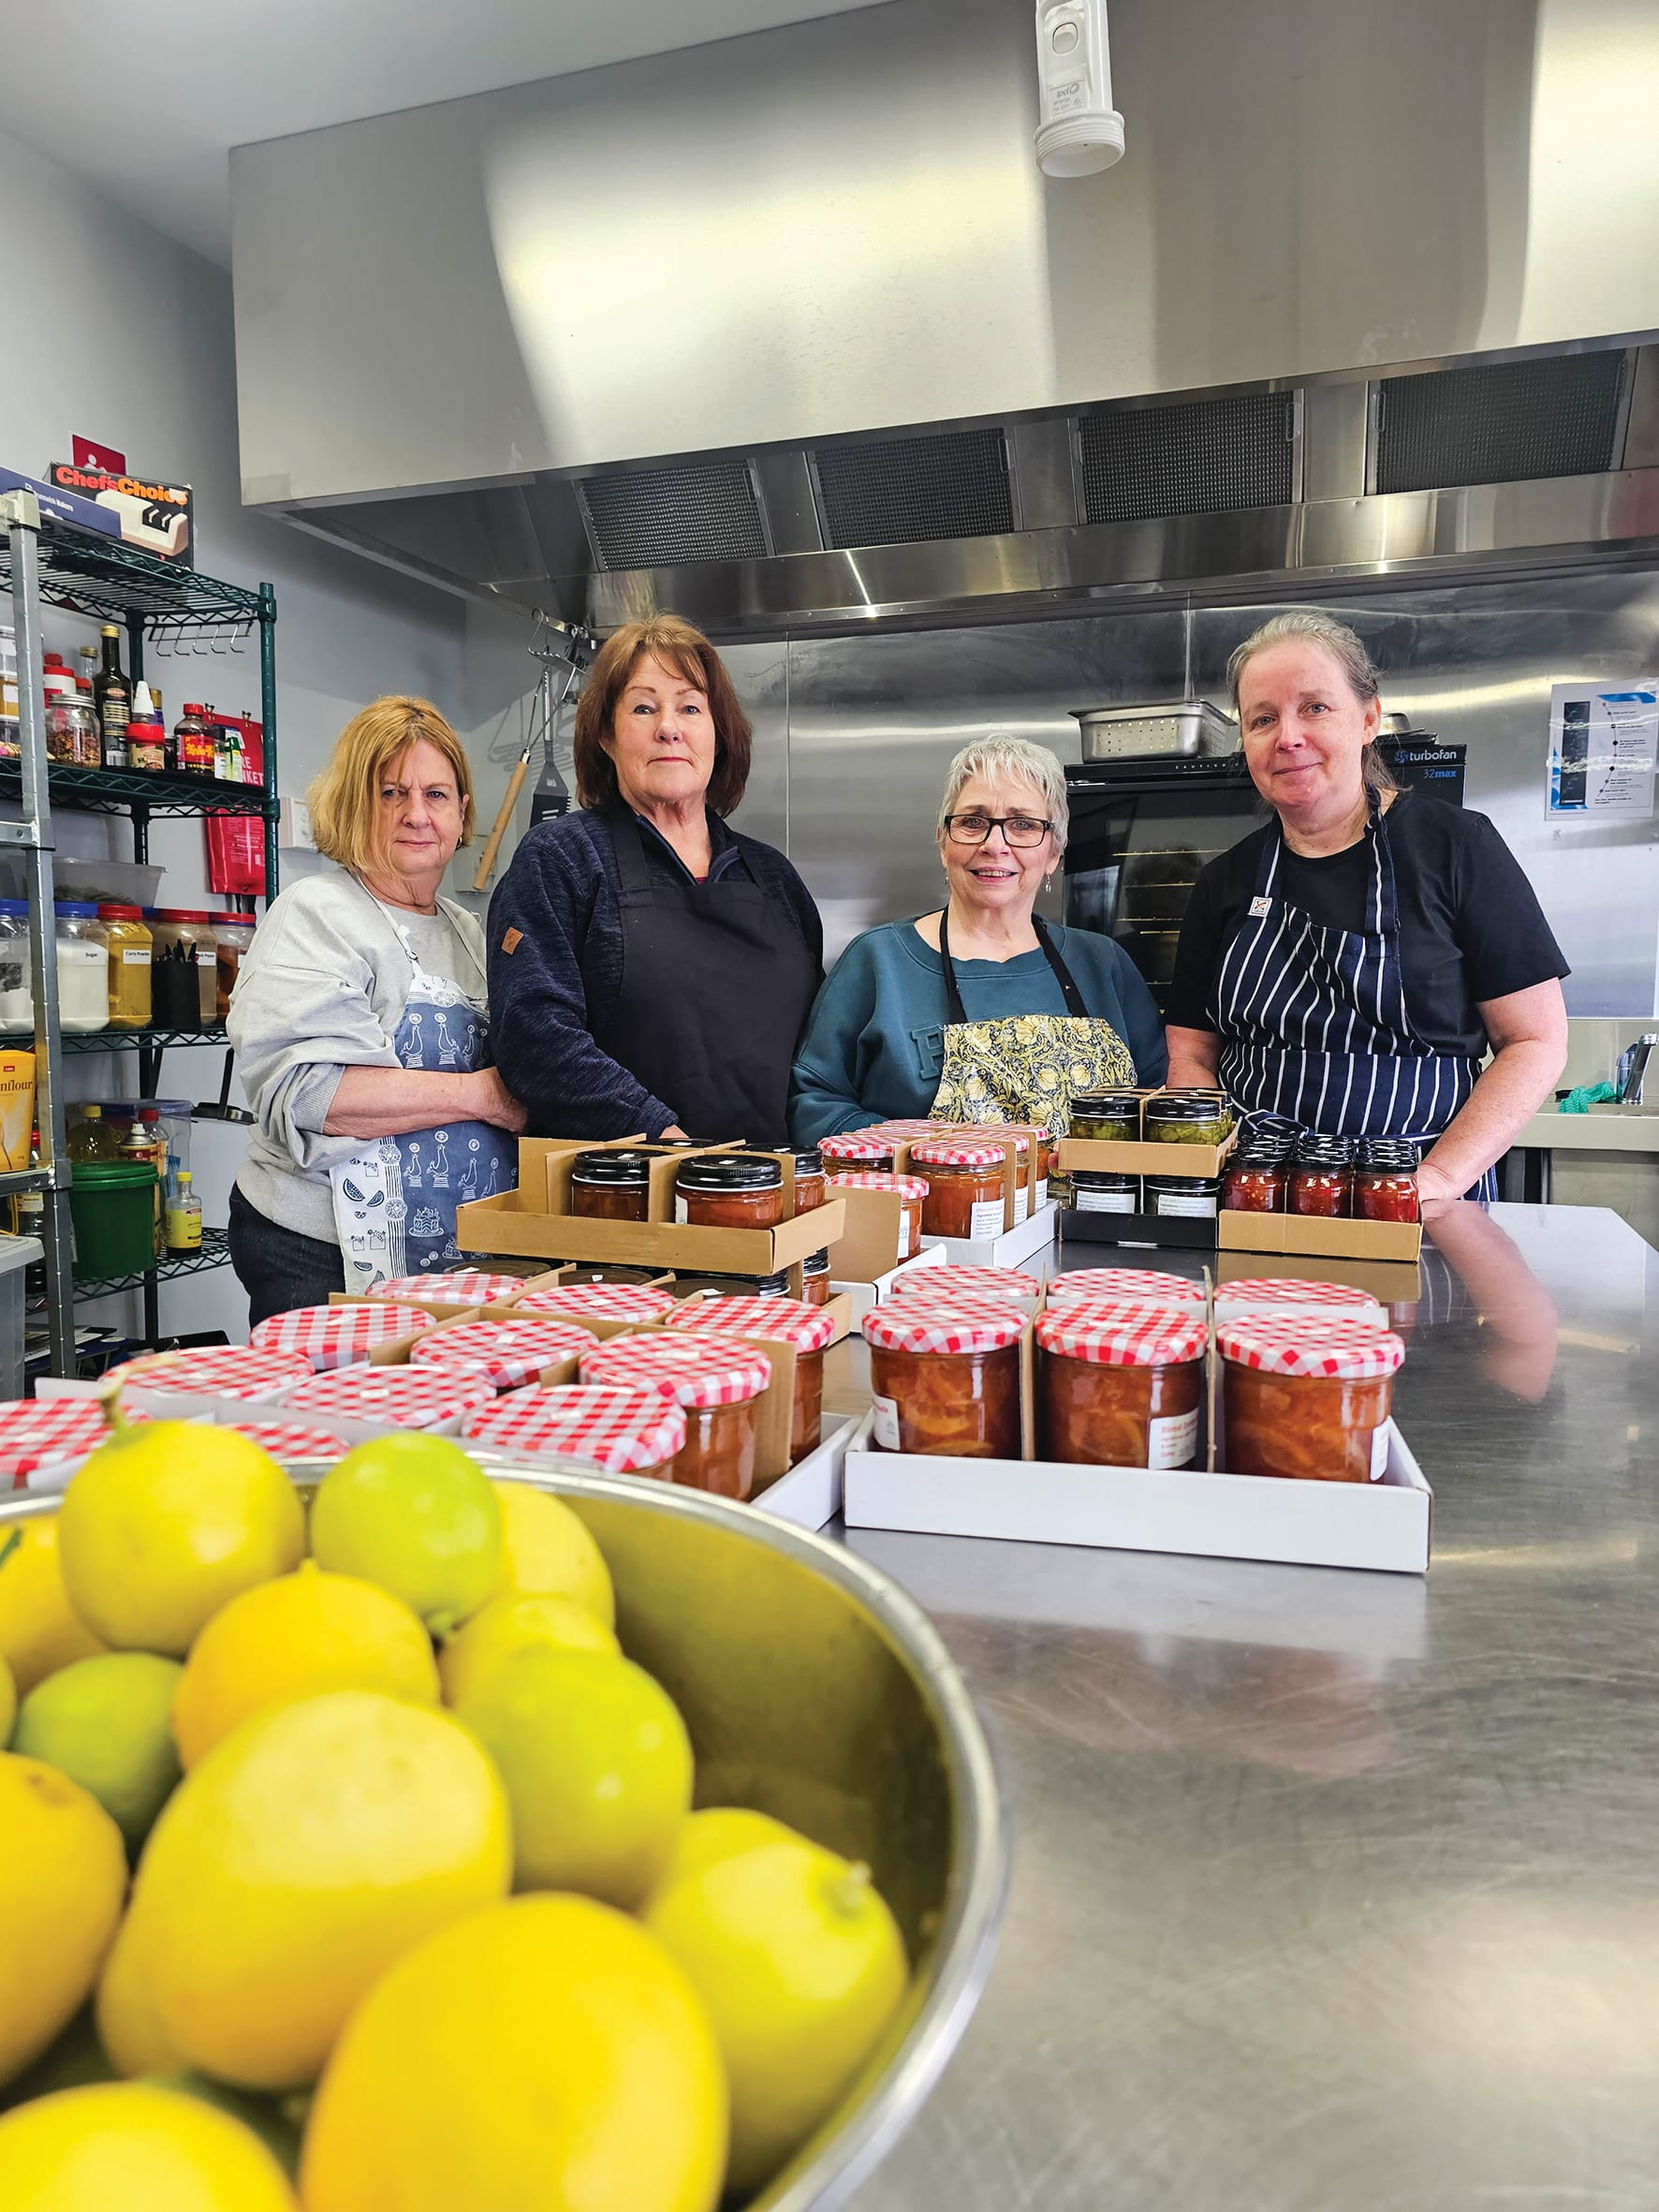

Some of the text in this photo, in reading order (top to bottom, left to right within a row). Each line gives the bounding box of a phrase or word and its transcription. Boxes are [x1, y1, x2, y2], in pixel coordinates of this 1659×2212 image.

[1409, 749, 1457, 761] turbofan
[1423, 769, 1458, 779] 32max
[0, 1079, 33, 1091] nflour
